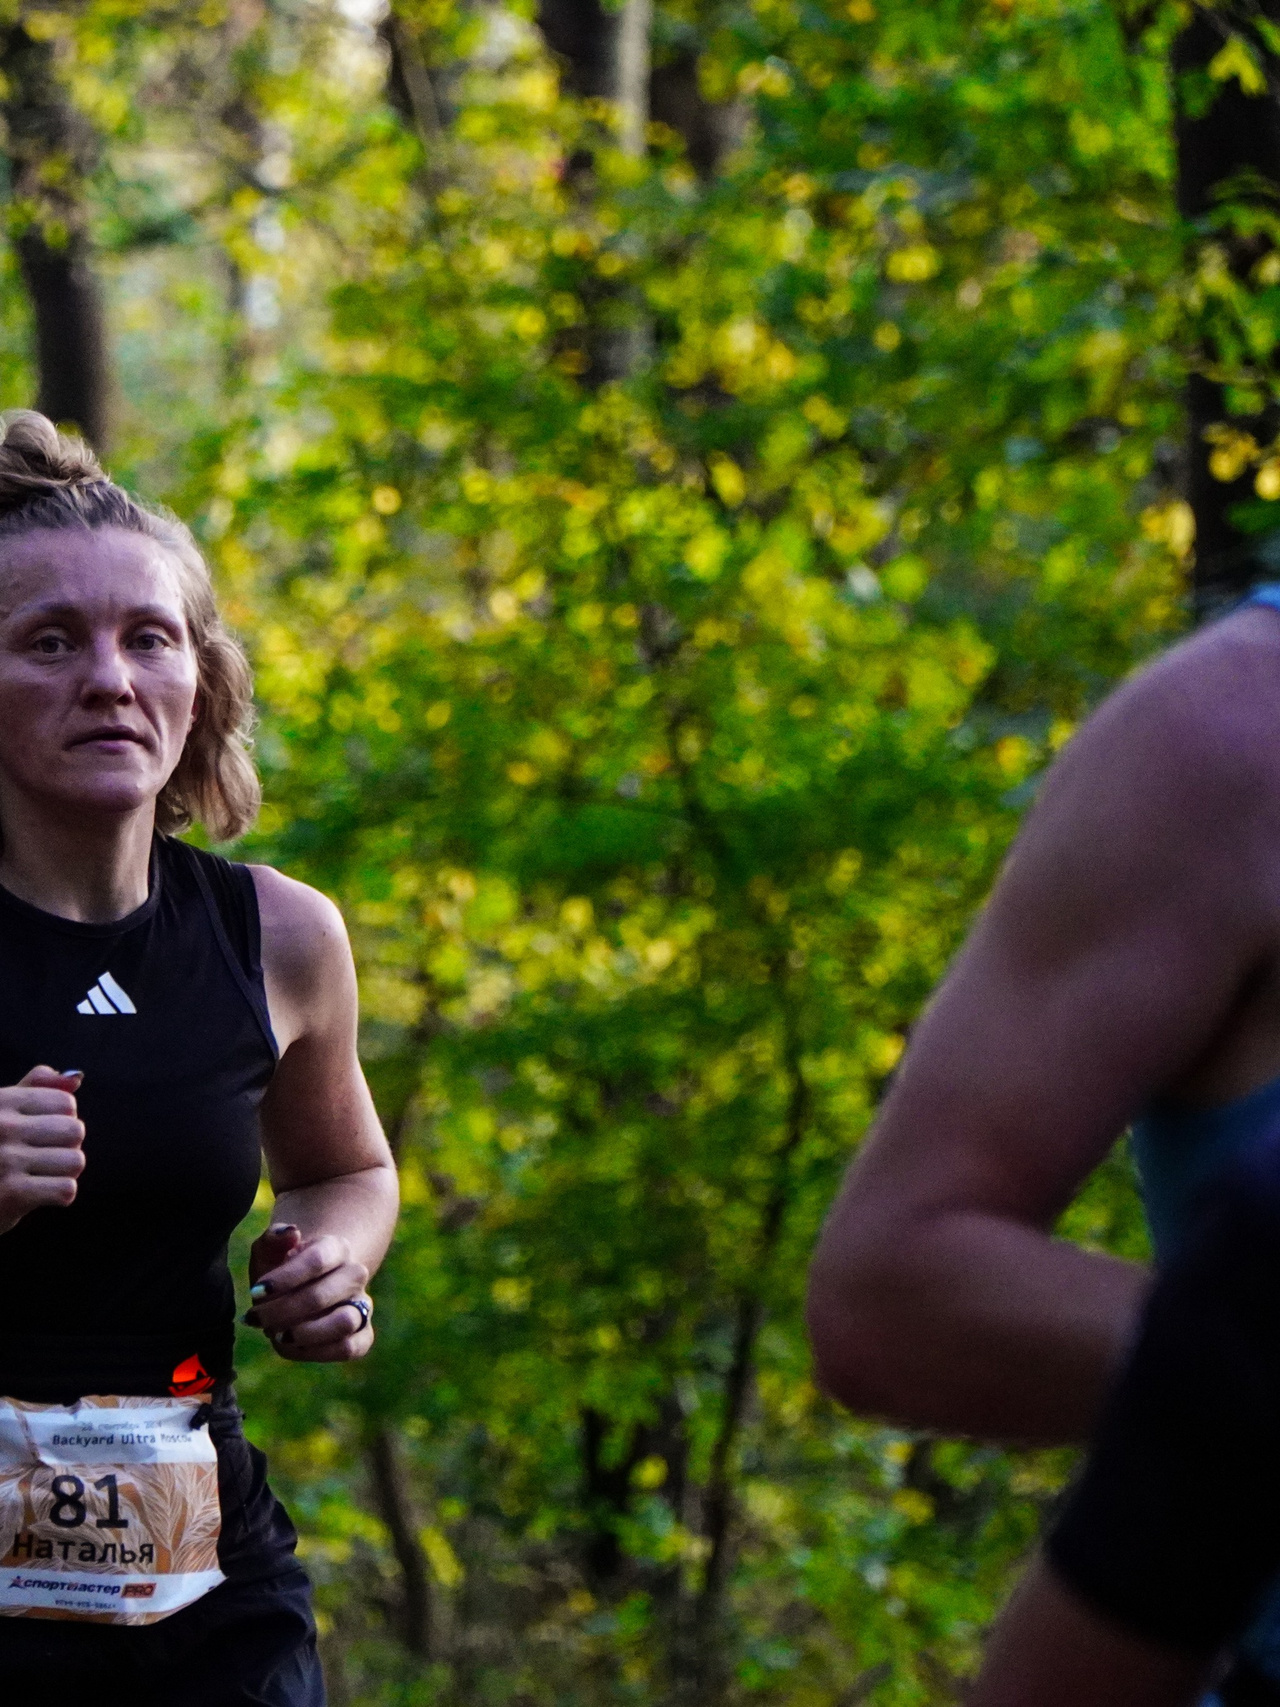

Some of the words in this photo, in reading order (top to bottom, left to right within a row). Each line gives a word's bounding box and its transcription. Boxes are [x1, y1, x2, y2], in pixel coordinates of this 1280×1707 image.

[52, 1433, 114, 1447] Backyard
[121, 1433, 156, 1445] Ultra
[49, 1473, 130, 1529] 81
[12, 1532, 155, 1564] Наталья
[123, 1583, 156, 1598] PRO
